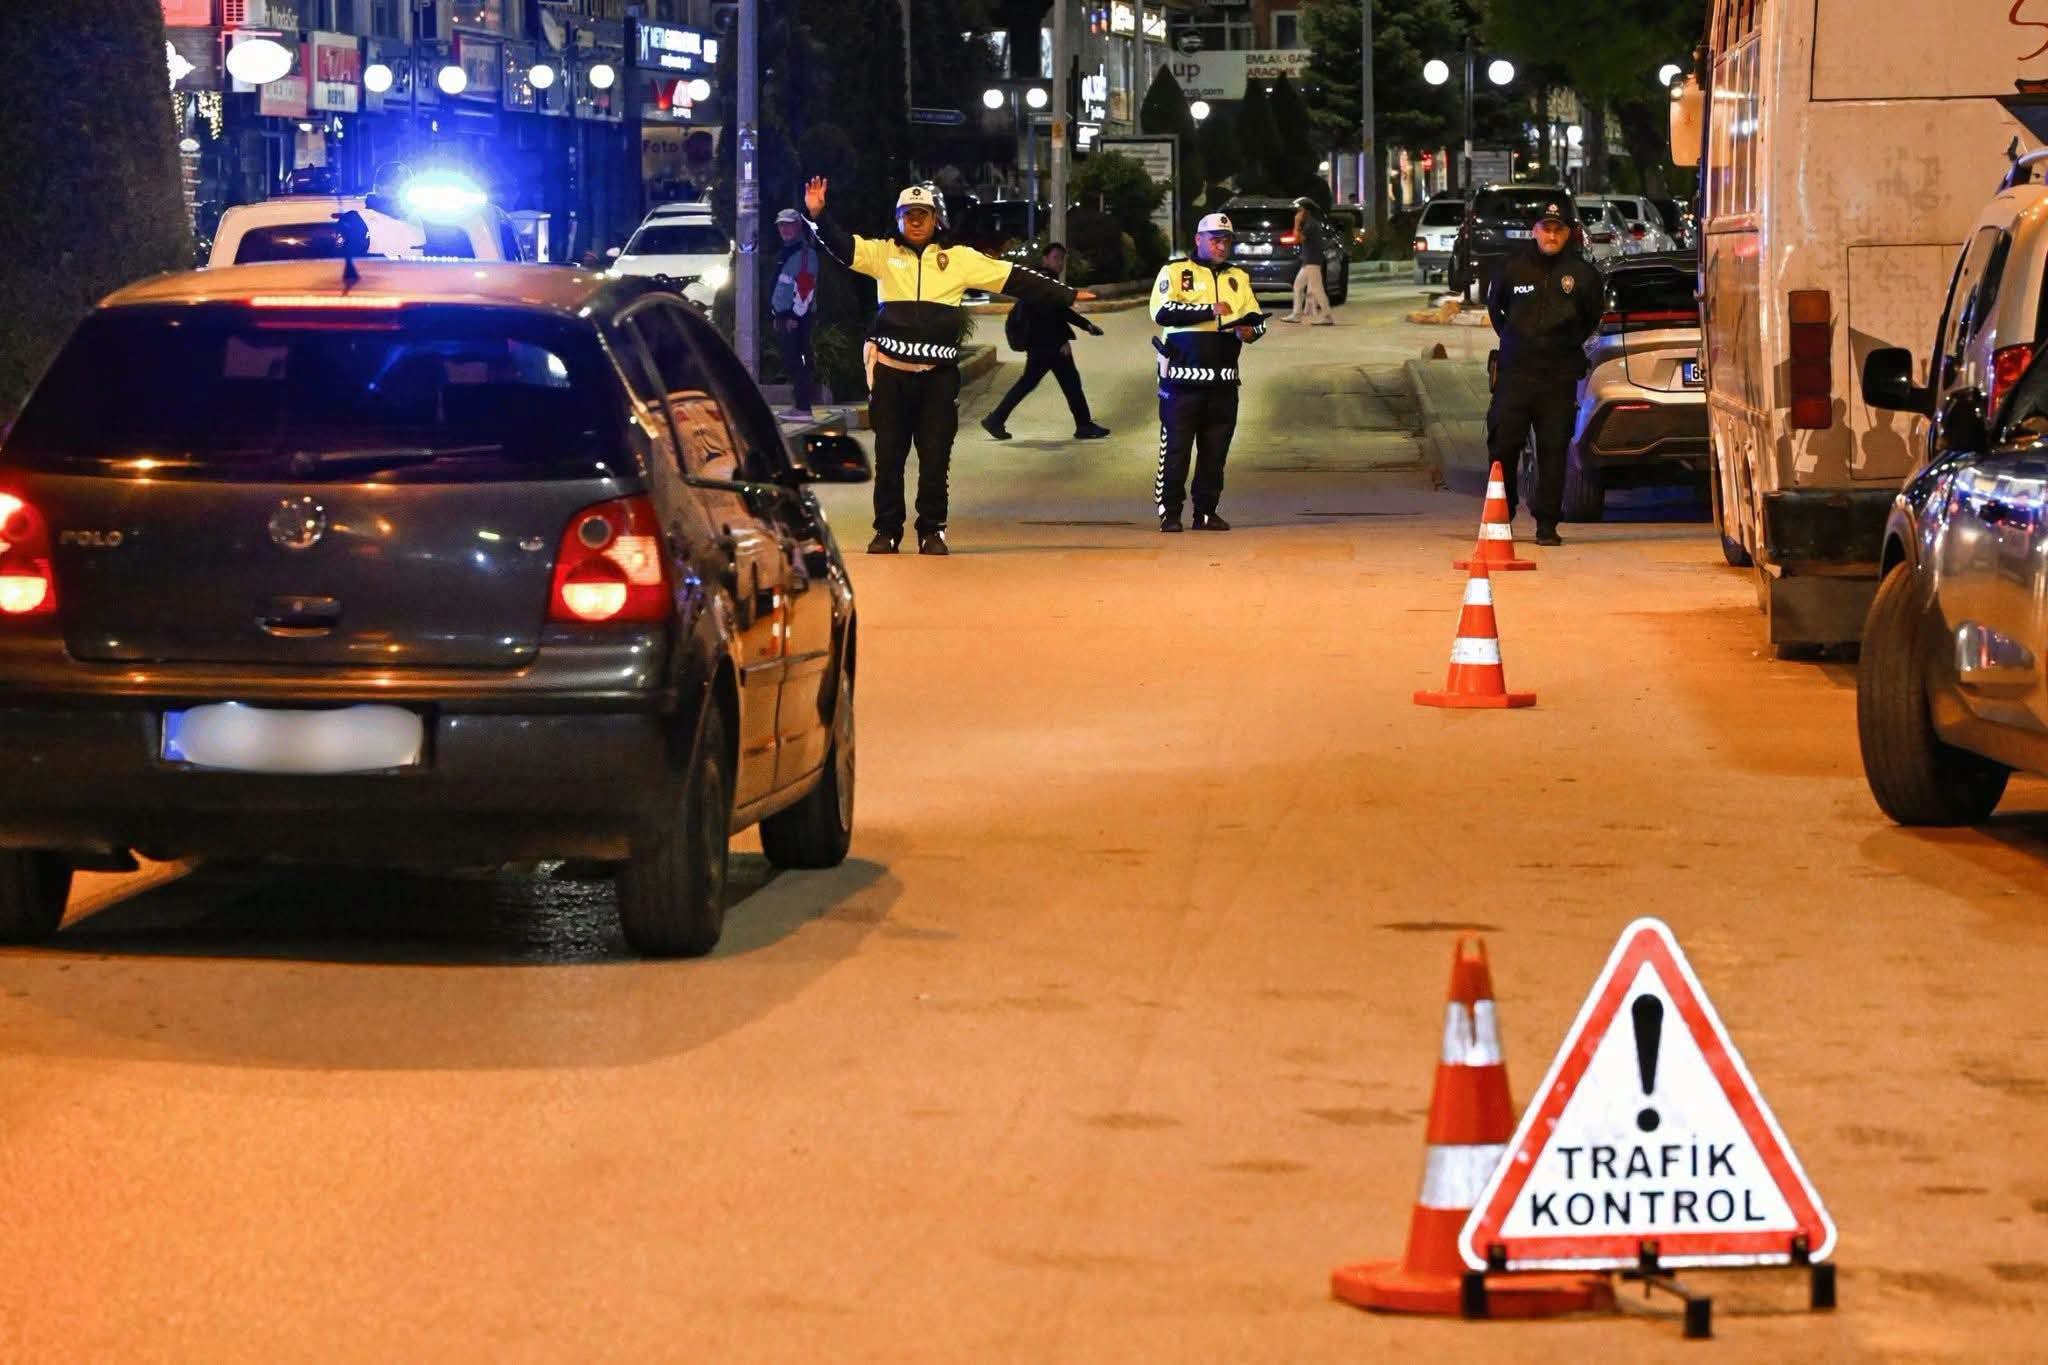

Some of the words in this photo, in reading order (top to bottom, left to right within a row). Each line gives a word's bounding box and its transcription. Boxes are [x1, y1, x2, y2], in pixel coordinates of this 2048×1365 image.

[60, 530, 123, 547] POLO
[1557, 1133, 1737, 1180] TRAFİK
[1530, 1188, 1766, 1227] KONTROL
